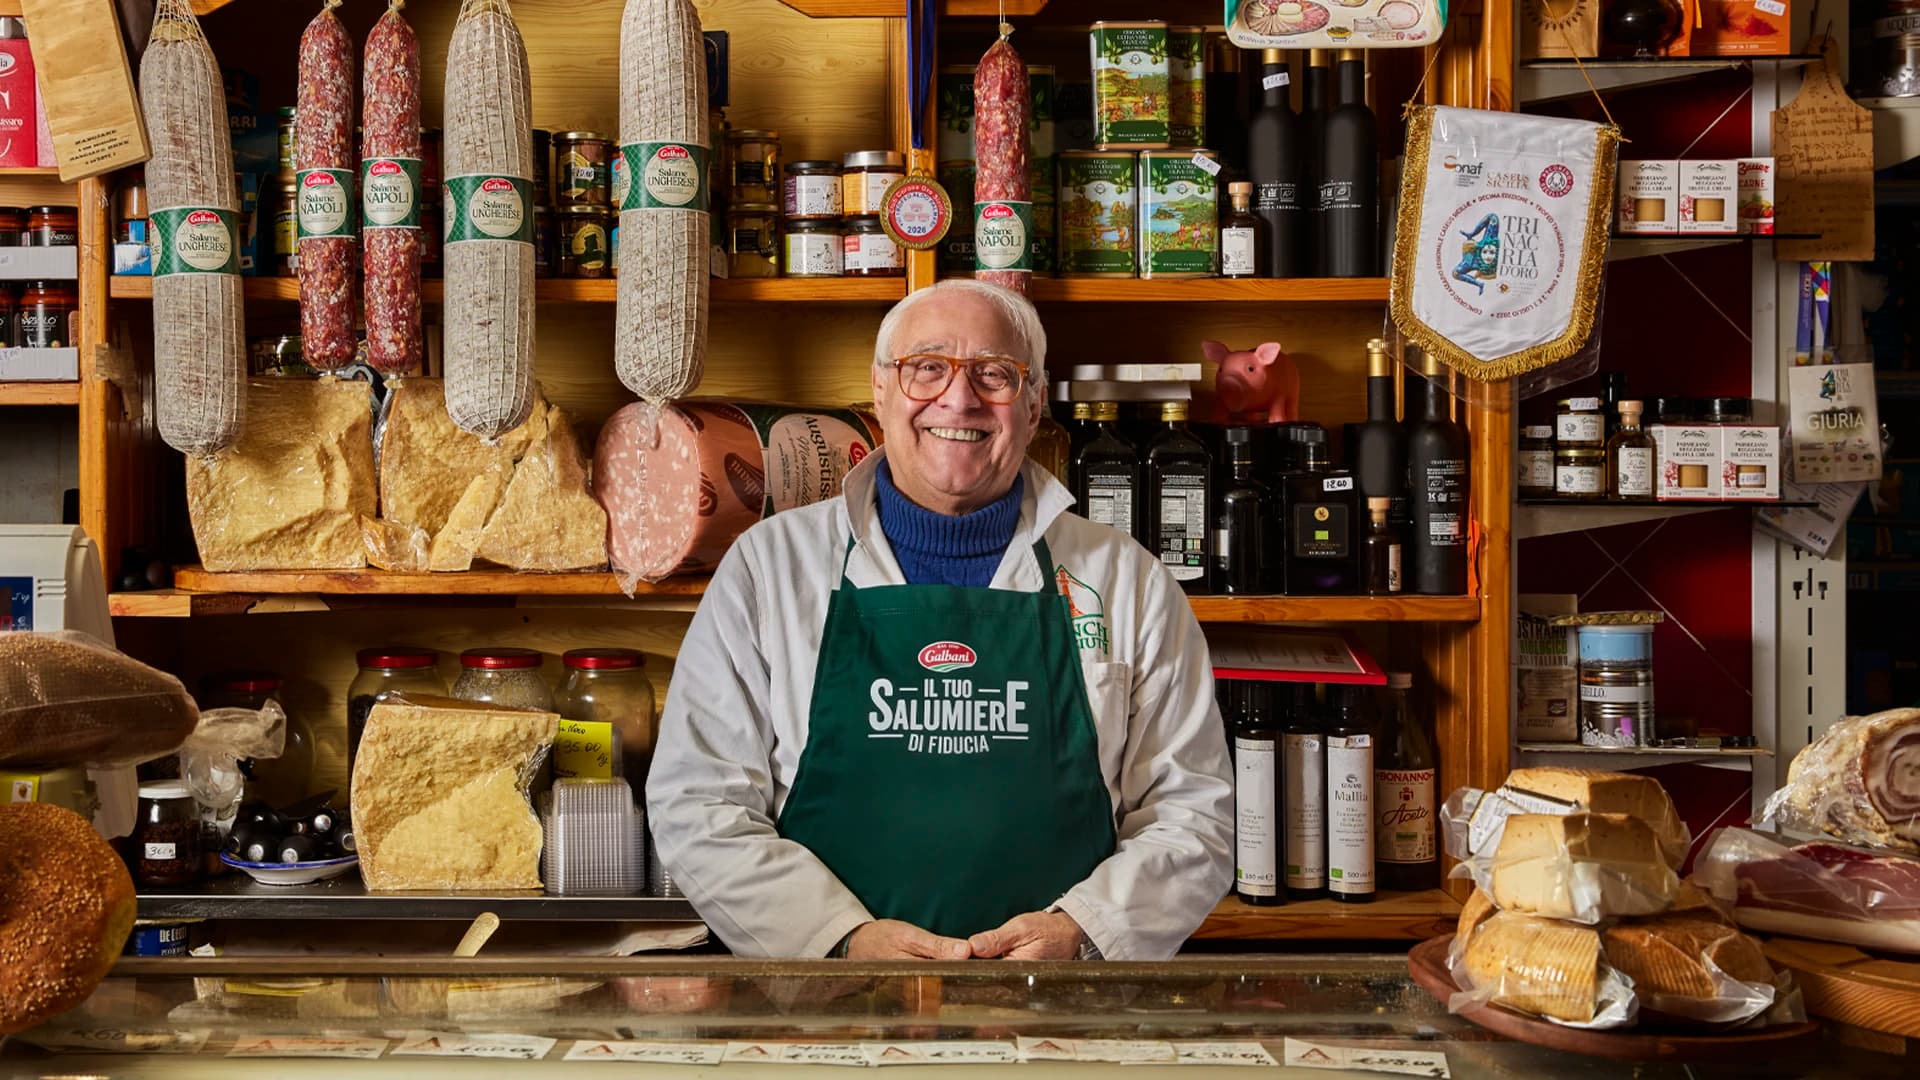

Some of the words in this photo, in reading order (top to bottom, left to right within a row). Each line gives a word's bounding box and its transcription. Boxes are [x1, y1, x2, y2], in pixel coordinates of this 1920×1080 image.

[660, 150, 686, 159] Galbani
[372, 165, 398, 173] Galbani
[658, 168, 688, 177] Salame
[306, 176, 331, 185] Galbani
[648, 177, 696, 188] UNGHERESE
[371, 184, 400, 192] Salame
[484, 182, 511, 191] Galbani
[305, 194, 335, 203] Salame
[366, 193, 409, 204] NAPOLI
[301, 203, 343, 215] NAPOLI
[483, 201, 513, 209] Salame
[189, 212, 217, 224] Galbani
[472, 209, 520, 219] UNGHERESE
[985, 208, 1010, 218] Galbani
[1504, 215, 1539, 234] TRI
[983, 227, 1012, 236] Salame
[189, 234, 220, 243] Salame
[978, 236, 1021, 248] NAPOLI
[1504, 233, 1539, 251] NAC
[179, 242, 227, 251] UNGHERESE
[1502, 248, 1537, 267] RIA
[1500, 265, 1539, 280] D'ORO
[1807, 412, 1865, 431] GIURIA
[925, 650, 970, 663] Galbani
[924, 679, 937, 697] IL
[942, 679, 972, 698] TUO
[908, 735, 923, 752] DI
[928, 735, 989, 754] FIDUCIA
[1379, 770, 1429, 783] BONANNO
[1334, 791, 1368, 802] Mallia
[1382, 804, 1430, 827] Aceto
[160, 928, 170, 943] DE
